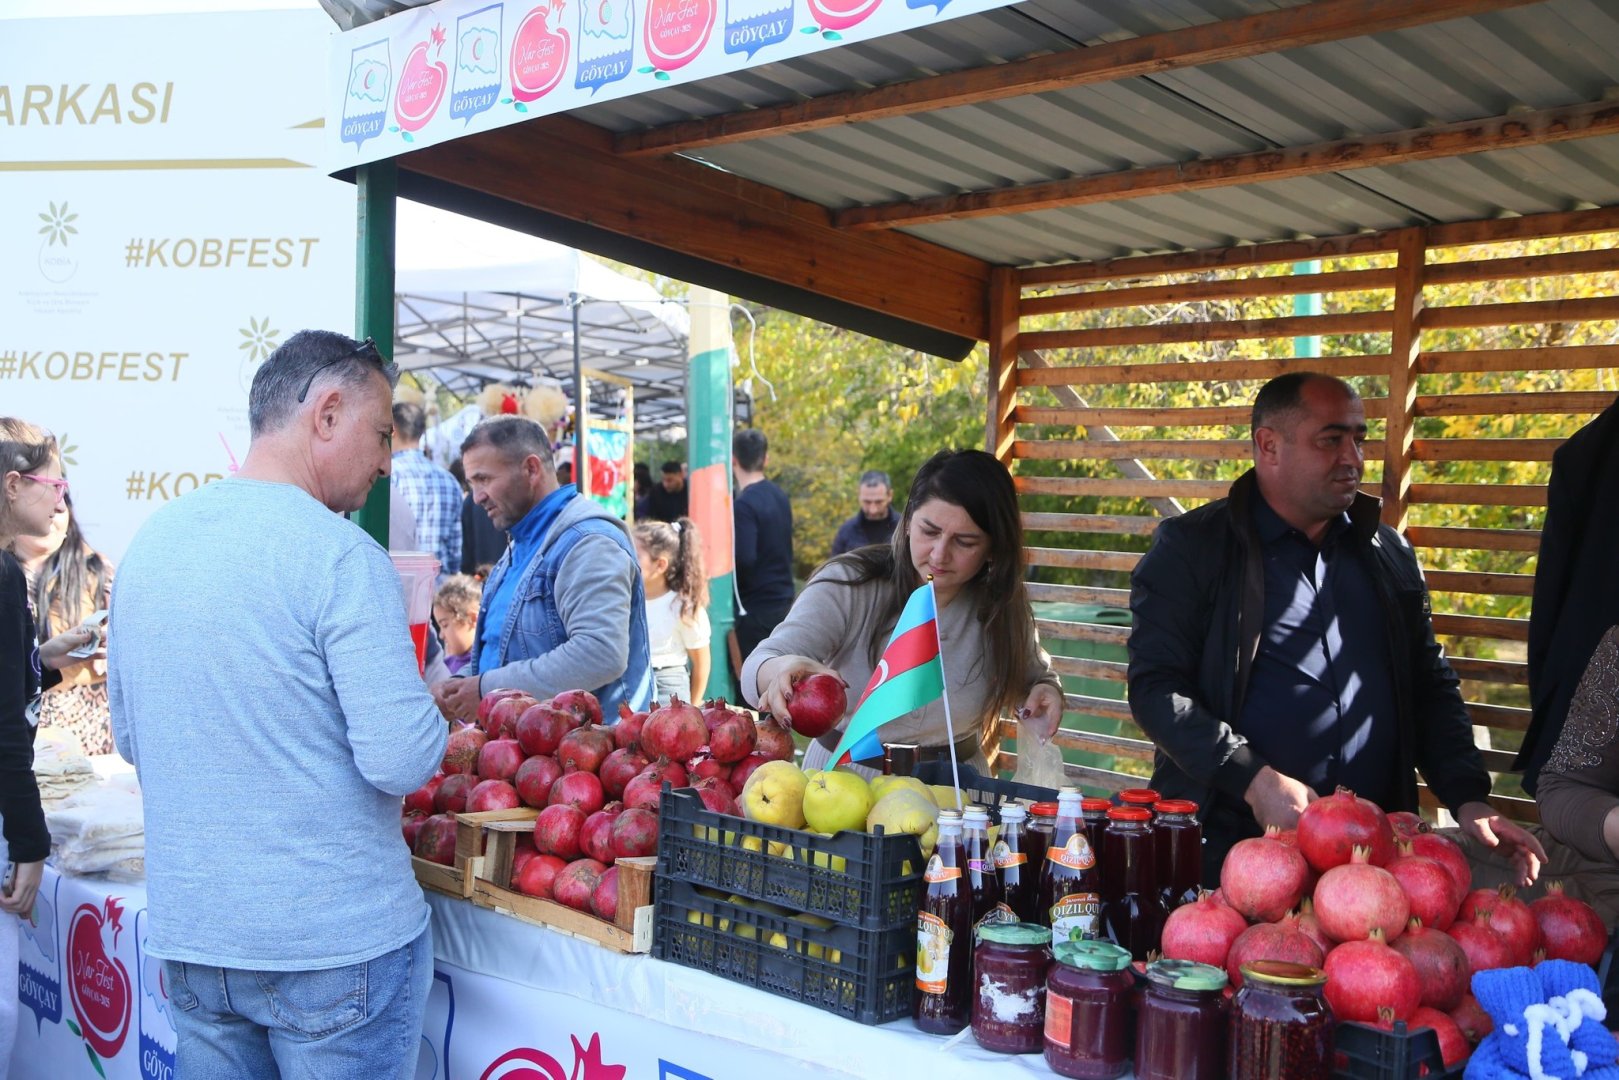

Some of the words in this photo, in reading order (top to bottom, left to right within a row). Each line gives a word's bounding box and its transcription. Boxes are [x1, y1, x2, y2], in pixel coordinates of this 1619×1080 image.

[730, 19, 788, 47] GÖYÇAY
[580, 60, 628, 83] GÖYÇAY
[453, 93, 495, 113] GÖYÇAY
[344, 119, 382, 137] GÖYÇAY
[125, 237, 320, 268] #KOBFEST
[0, 350, 189, 382] #KOBFEST
[76, 949, 95, 980] Nar
[19, 973, 58, 1012] GÖYÇAY
